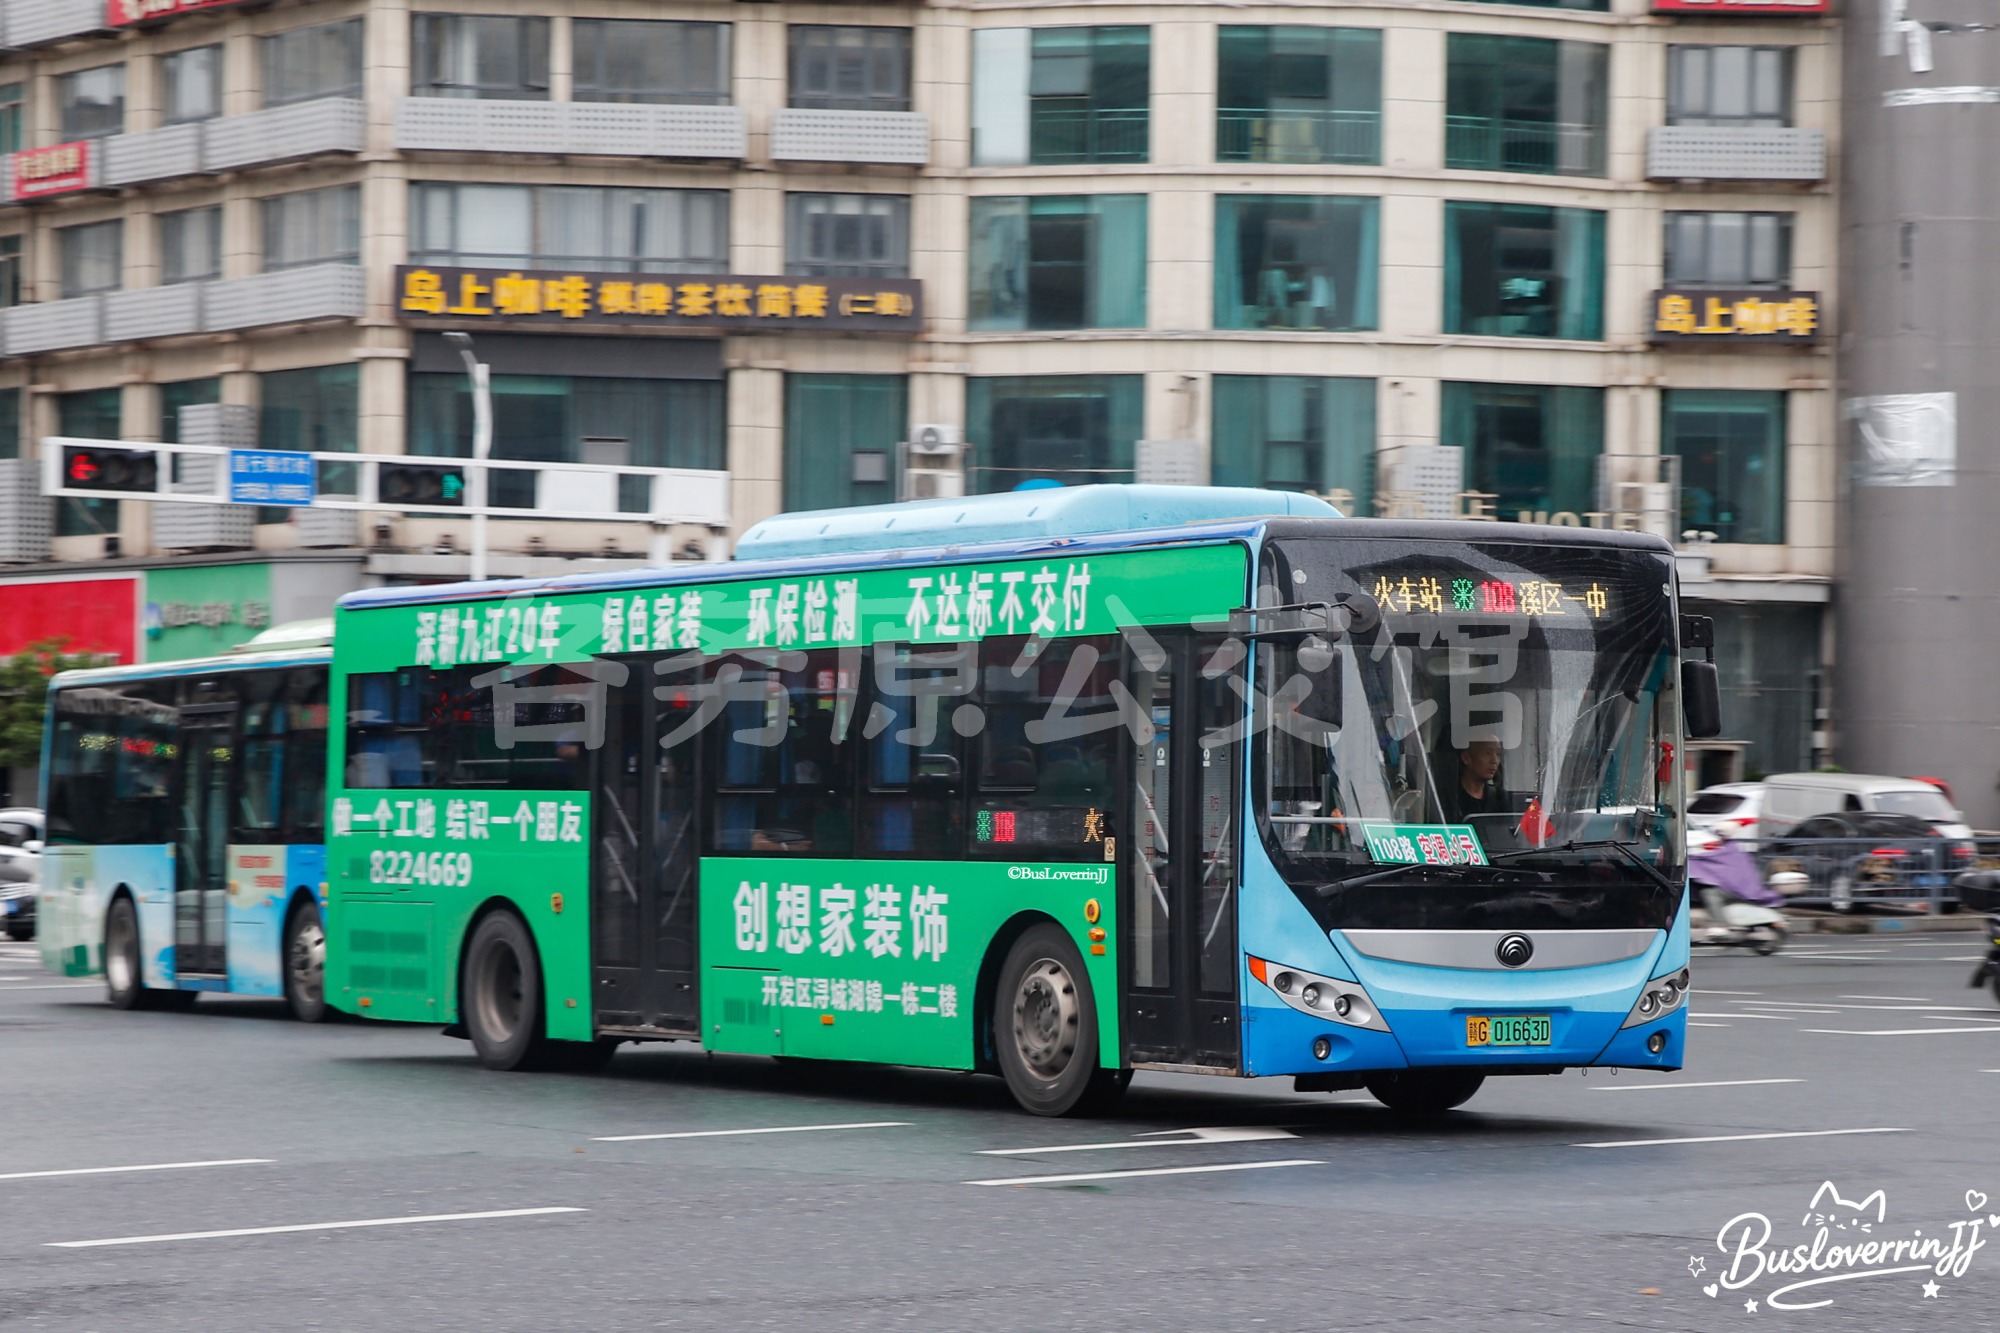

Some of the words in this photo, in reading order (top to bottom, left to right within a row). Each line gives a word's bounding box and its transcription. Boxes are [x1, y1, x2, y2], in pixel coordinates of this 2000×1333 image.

[401, 268, 592, 319] 岛上咖啡
[1655, 294, 1819, 336] 岛上咖啡
[415, 601, 562, 665] 深耕九江20年
[602, 590, 702, 653] 绿色家装
[746, 578, 858, 648] 环保检测
[905, 562, 1091, 640] 不达标不交付
[1374, 575, 1443, 613] 火车站
[445, 798, 583, 843] 结识一个朋友
[369, 849, 473, 888] 8224669
[1374, 835, 1419, 864] 108路
[732, 880, 950, 963] 创想家装饰
